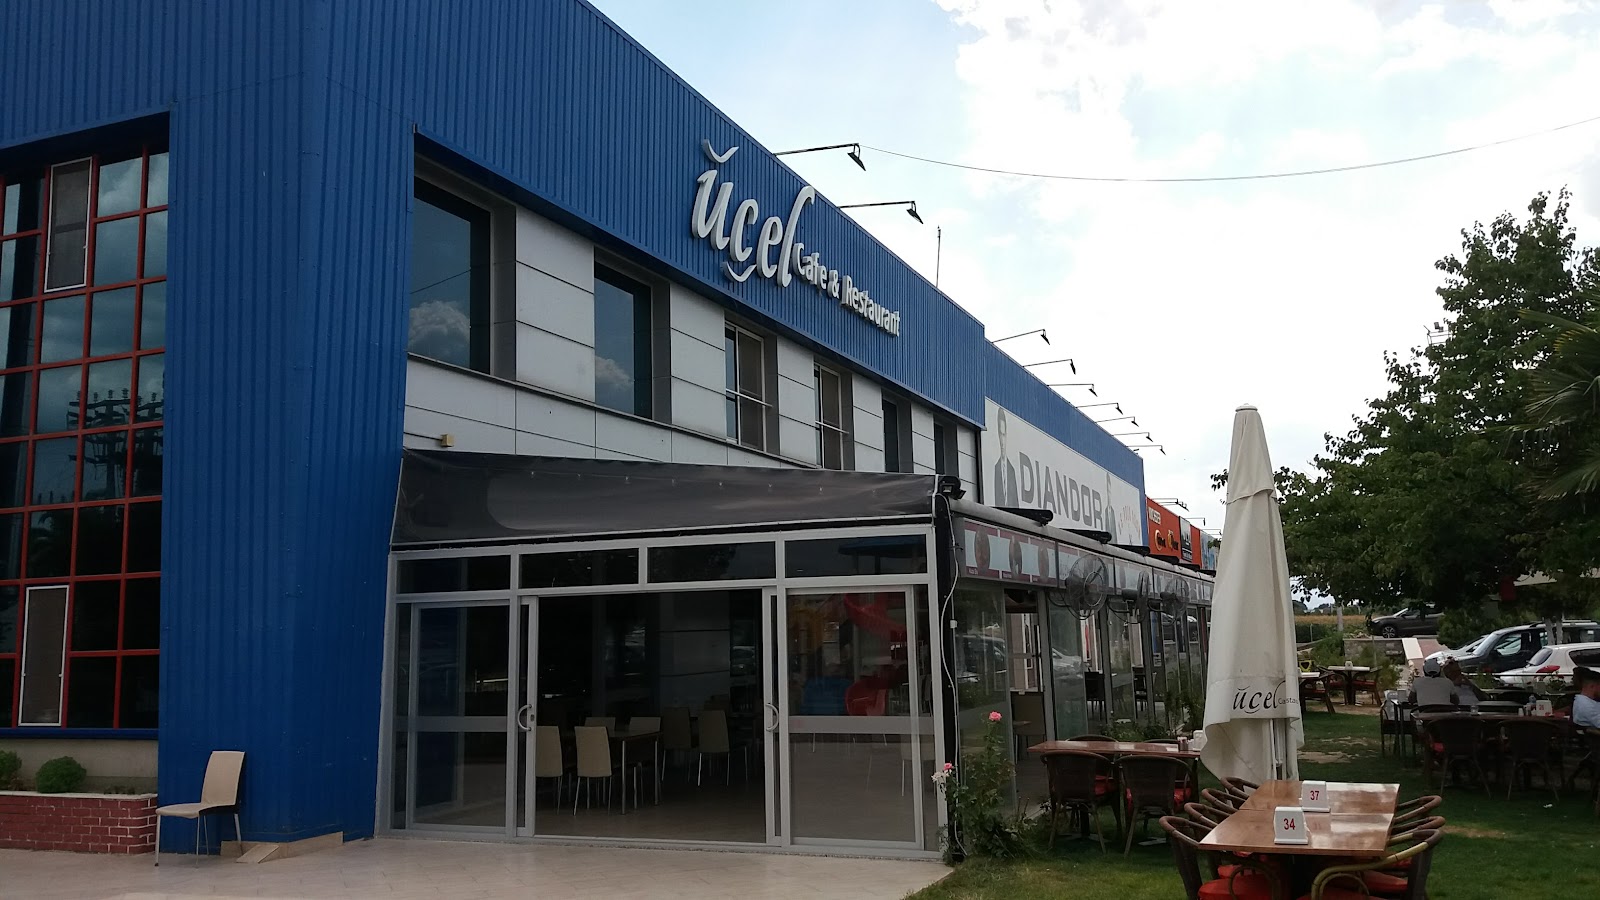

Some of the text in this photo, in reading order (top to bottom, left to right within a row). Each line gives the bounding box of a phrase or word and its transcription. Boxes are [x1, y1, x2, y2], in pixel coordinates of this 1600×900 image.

[791, 242, 901, 337] Cafe & Restaurant
[1019, 451, 1103, 530] DIANDOR
[1309, 790, 1320, 801] 37
[1283, 817, 1296, 831] 34
